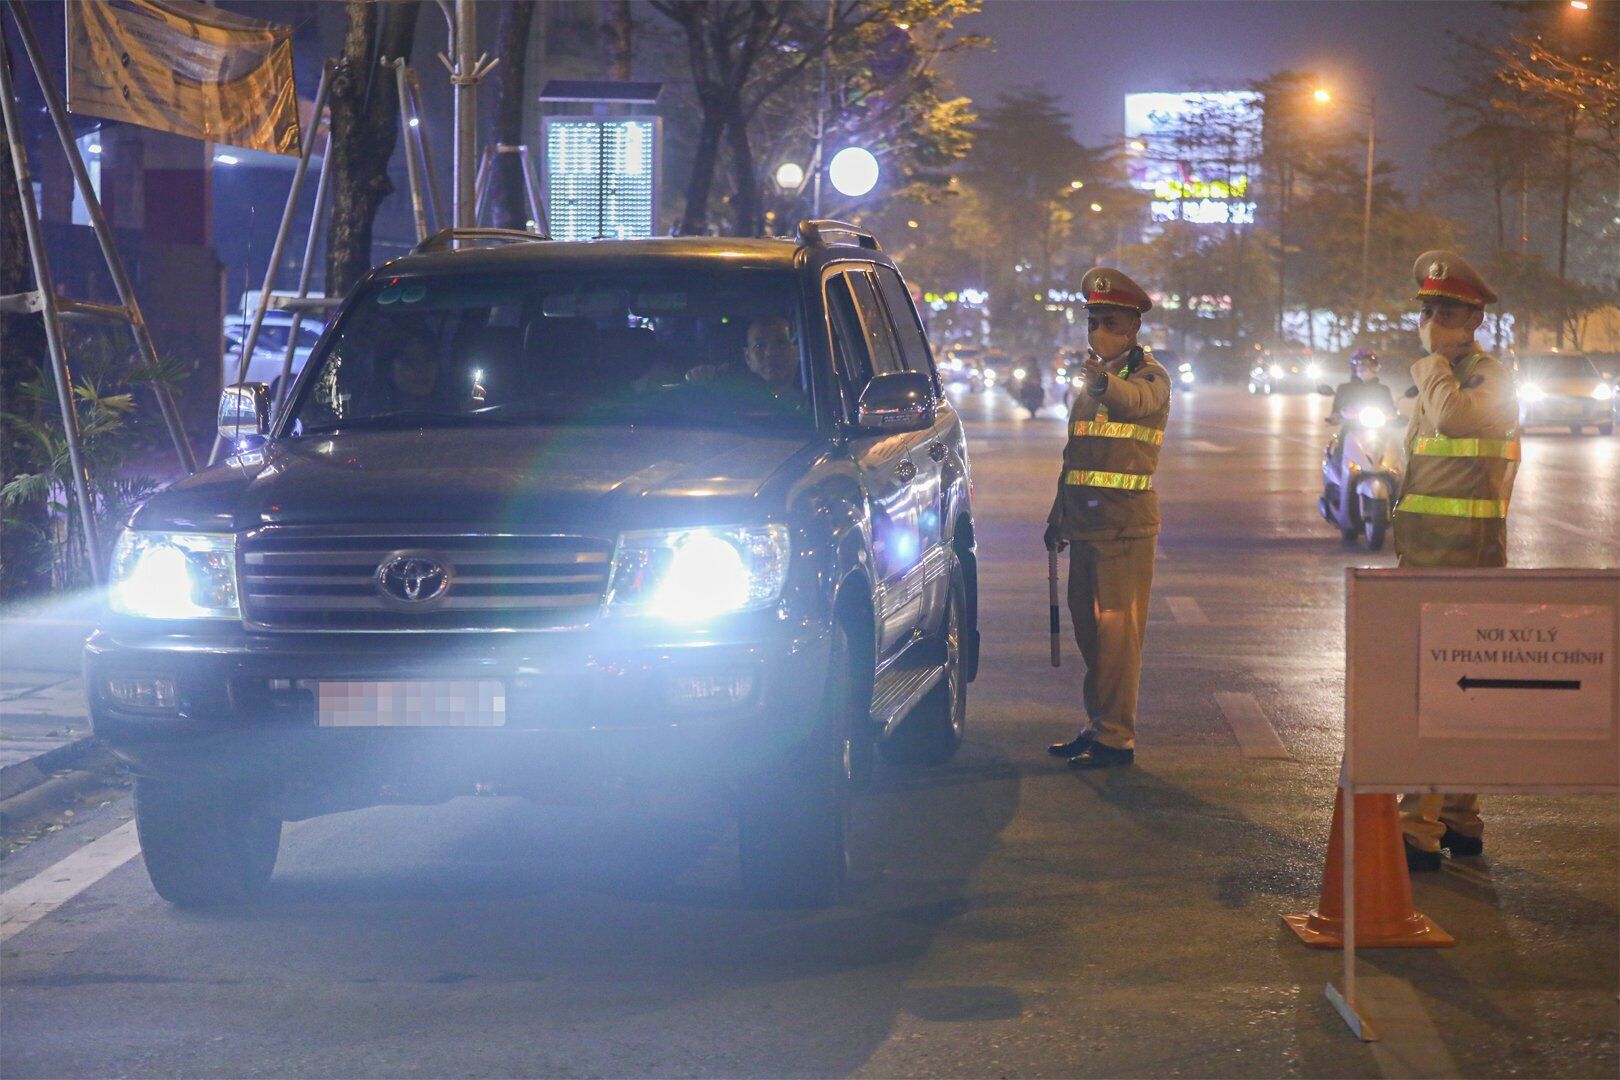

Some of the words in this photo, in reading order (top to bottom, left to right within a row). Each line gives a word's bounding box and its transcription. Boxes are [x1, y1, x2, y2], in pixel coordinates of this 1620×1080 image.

[1477, 628, 1505, 641] NƠI
[1536, 627, 1558, 642] LÝ
[1431, 650, 1447, 662] VI
[1451, 650, 1498, 665] PHẠM
[1502, 647, 1548, 664] HÀNH
[1552, 648, 1604, 665] CHÍNH
